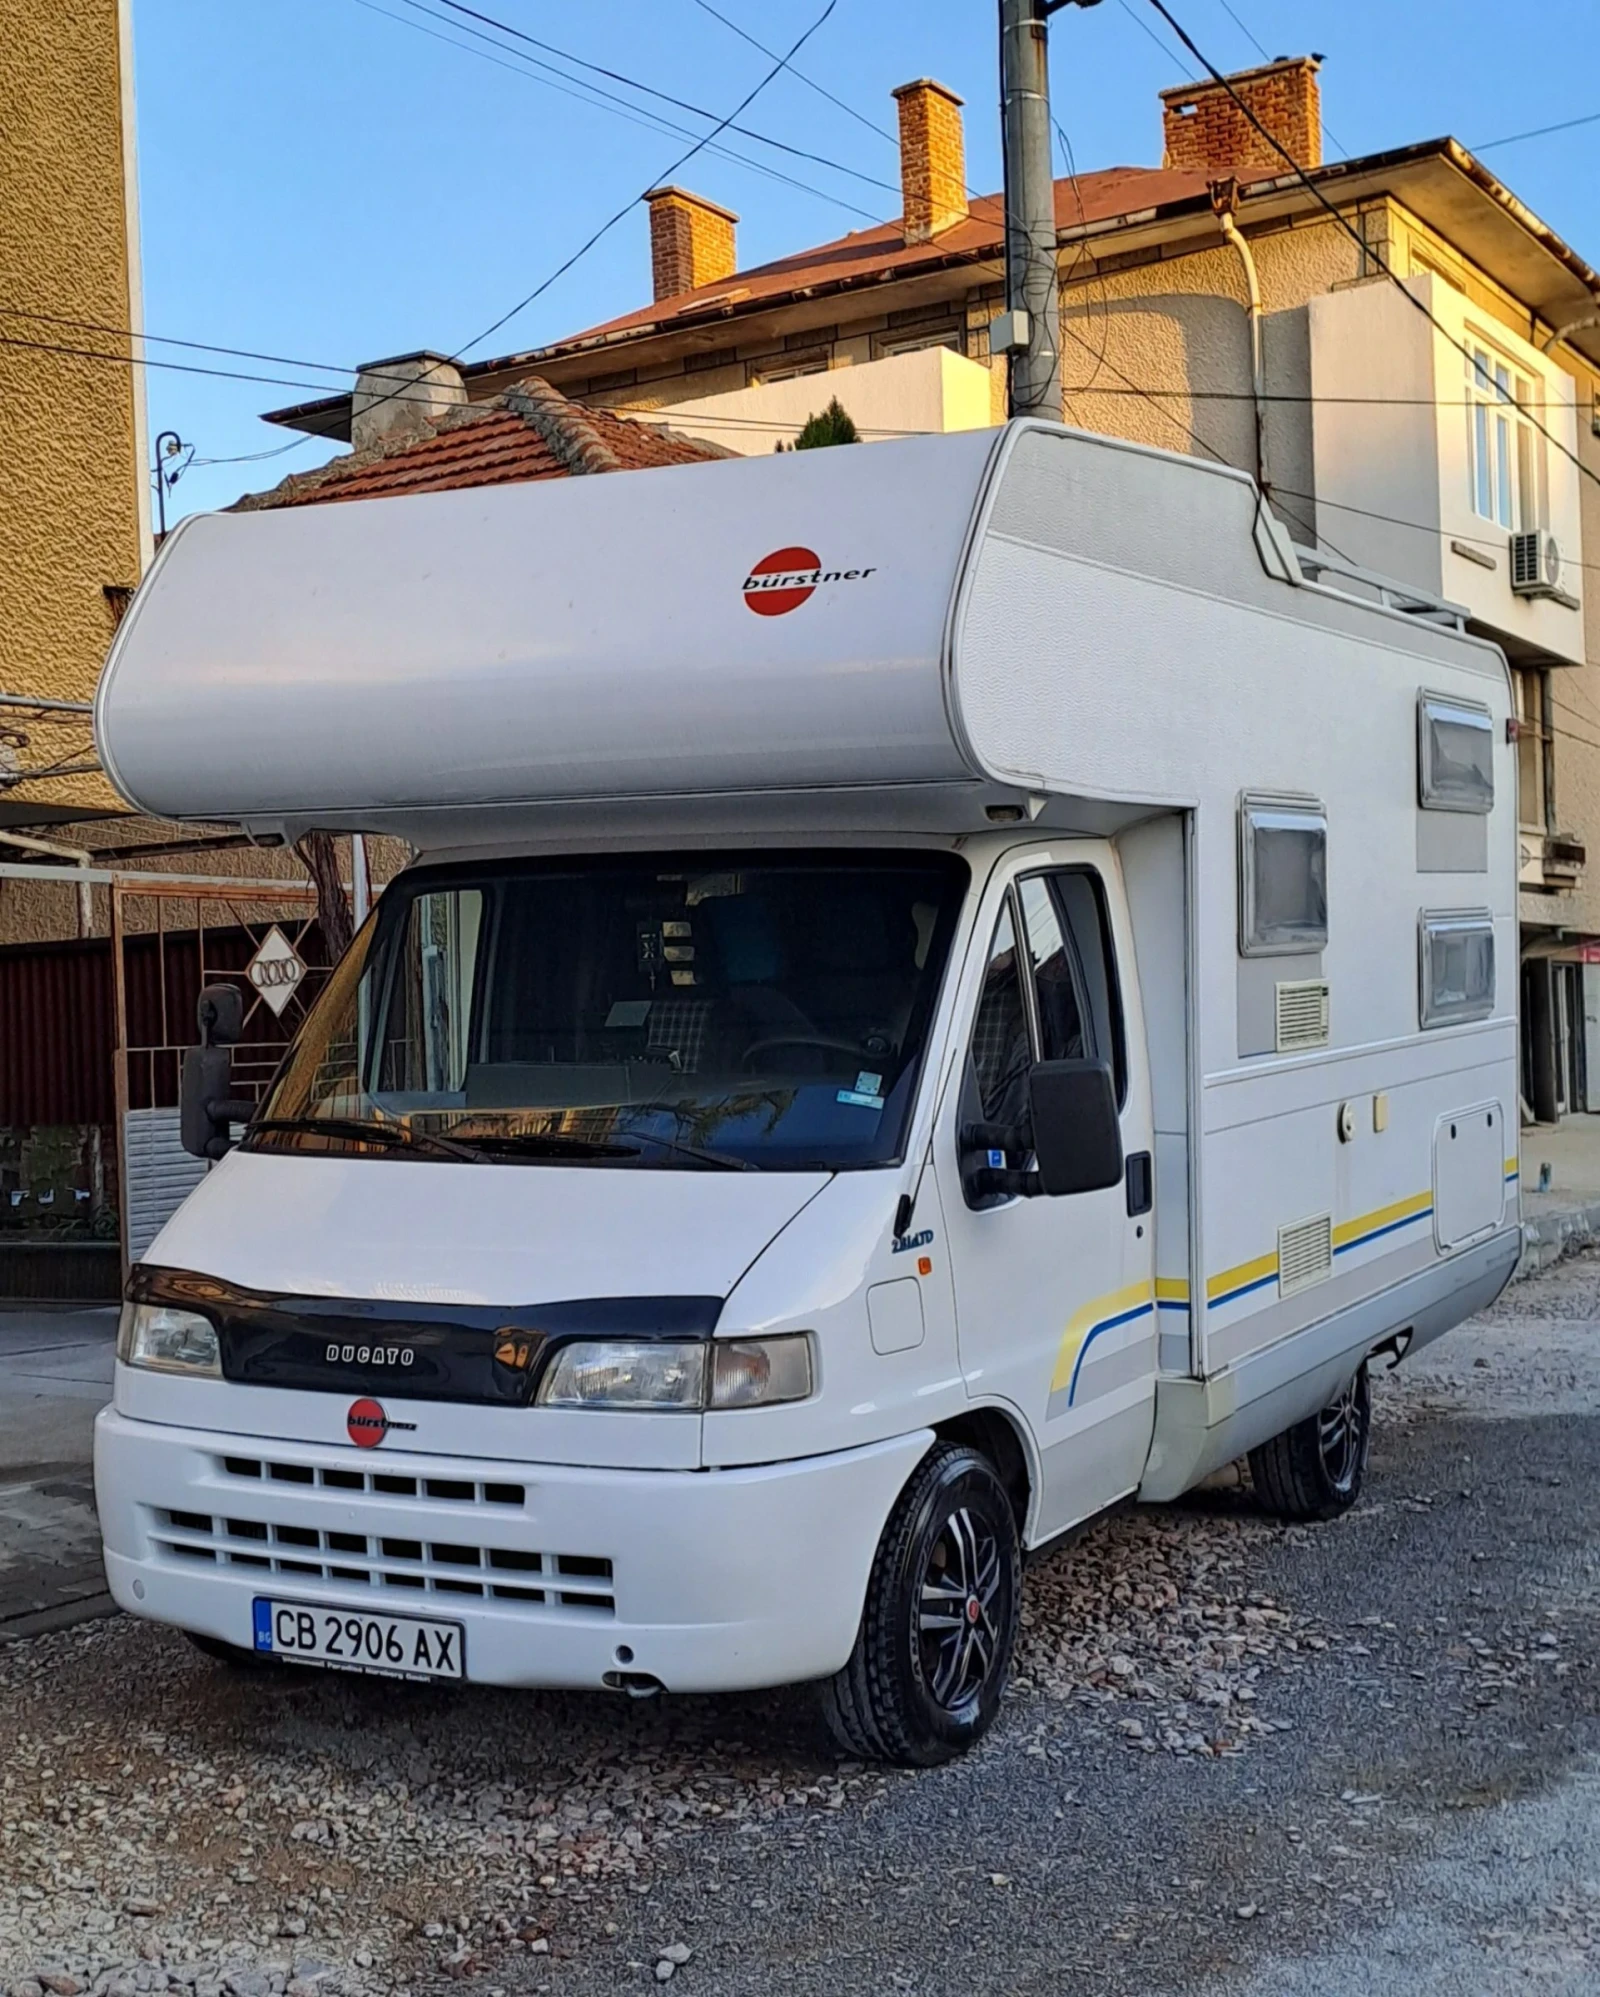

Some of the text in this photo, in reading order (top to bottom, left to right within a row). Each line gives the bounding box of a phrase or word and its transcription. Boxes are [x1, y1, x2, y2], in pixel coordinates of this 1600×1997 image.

[741, 566, 877, 590] bürstner
[326, 1344, 414, 1366] DUCATO
[258, 1630, 271, 1644] BG
[276, 1609, 455, 1672] CB 2906 AX
